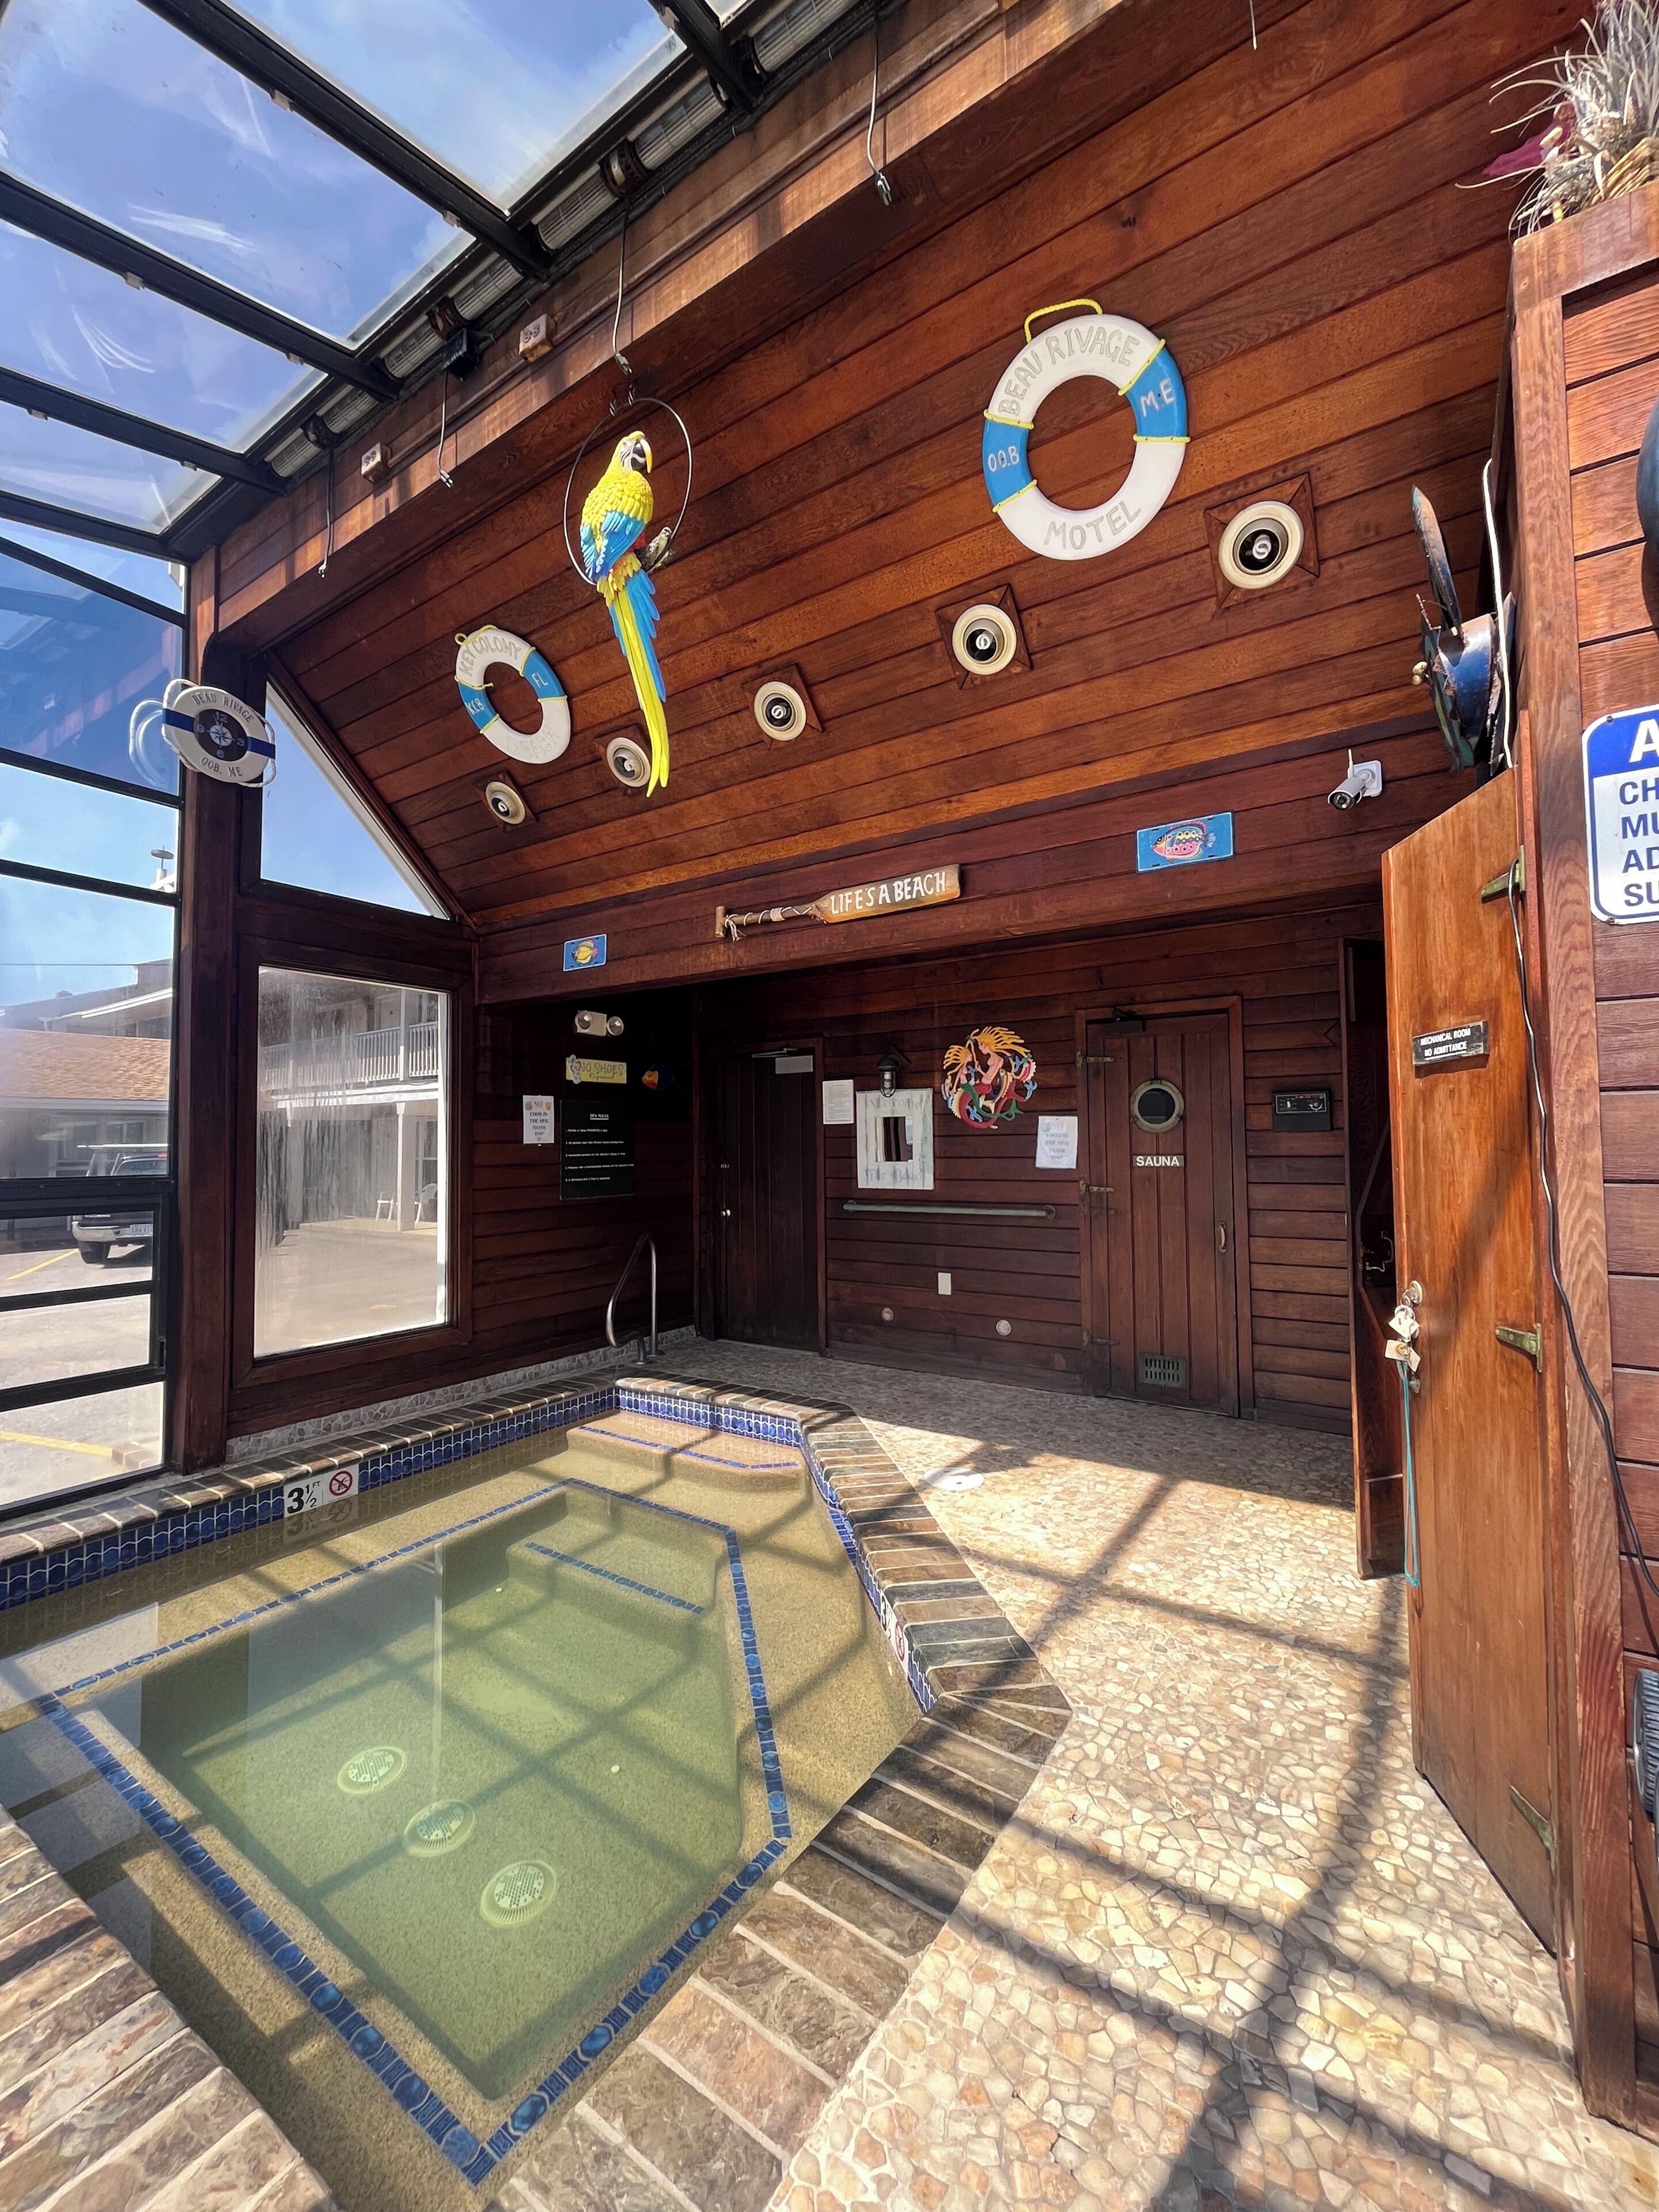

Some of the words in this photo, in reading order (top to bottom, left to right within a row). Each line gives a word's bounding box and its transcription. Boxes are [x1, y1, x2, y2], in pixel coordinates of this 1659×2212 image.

[998, 350, 1043, 417] BEAU
[1045, 325, 1141, 367] RIVAGE
[1044, 501, 1141, 550] MOTEL
[459, 644, 476, 676] KEY
[471, 636, 521, 660] COLONY
[192, 692, 217, 706] BEAU
[224, 696, 255, 723] RIVAGE
[465, 698, 484, 716] KCB
[506, 724, 560, 759] BEACH
[228, 766, 243, 777] ME
[878, 883, 891, 906] A
[893, 871, 946, 902] BEACH
[1420, 1032, 1453, 1046] MECHANICAL
[1453, 1028, 1471, 1039] ROOM
[1424, 1048, 1433, 1057] NO
[1433, 1041, 1468, 1056] ADMITTANCE
[594, 1062, 624, 1076] SHOES
[1136, 1156, 1180, 1166] SAUNA
[312, 1480, 321, 1488] FT
